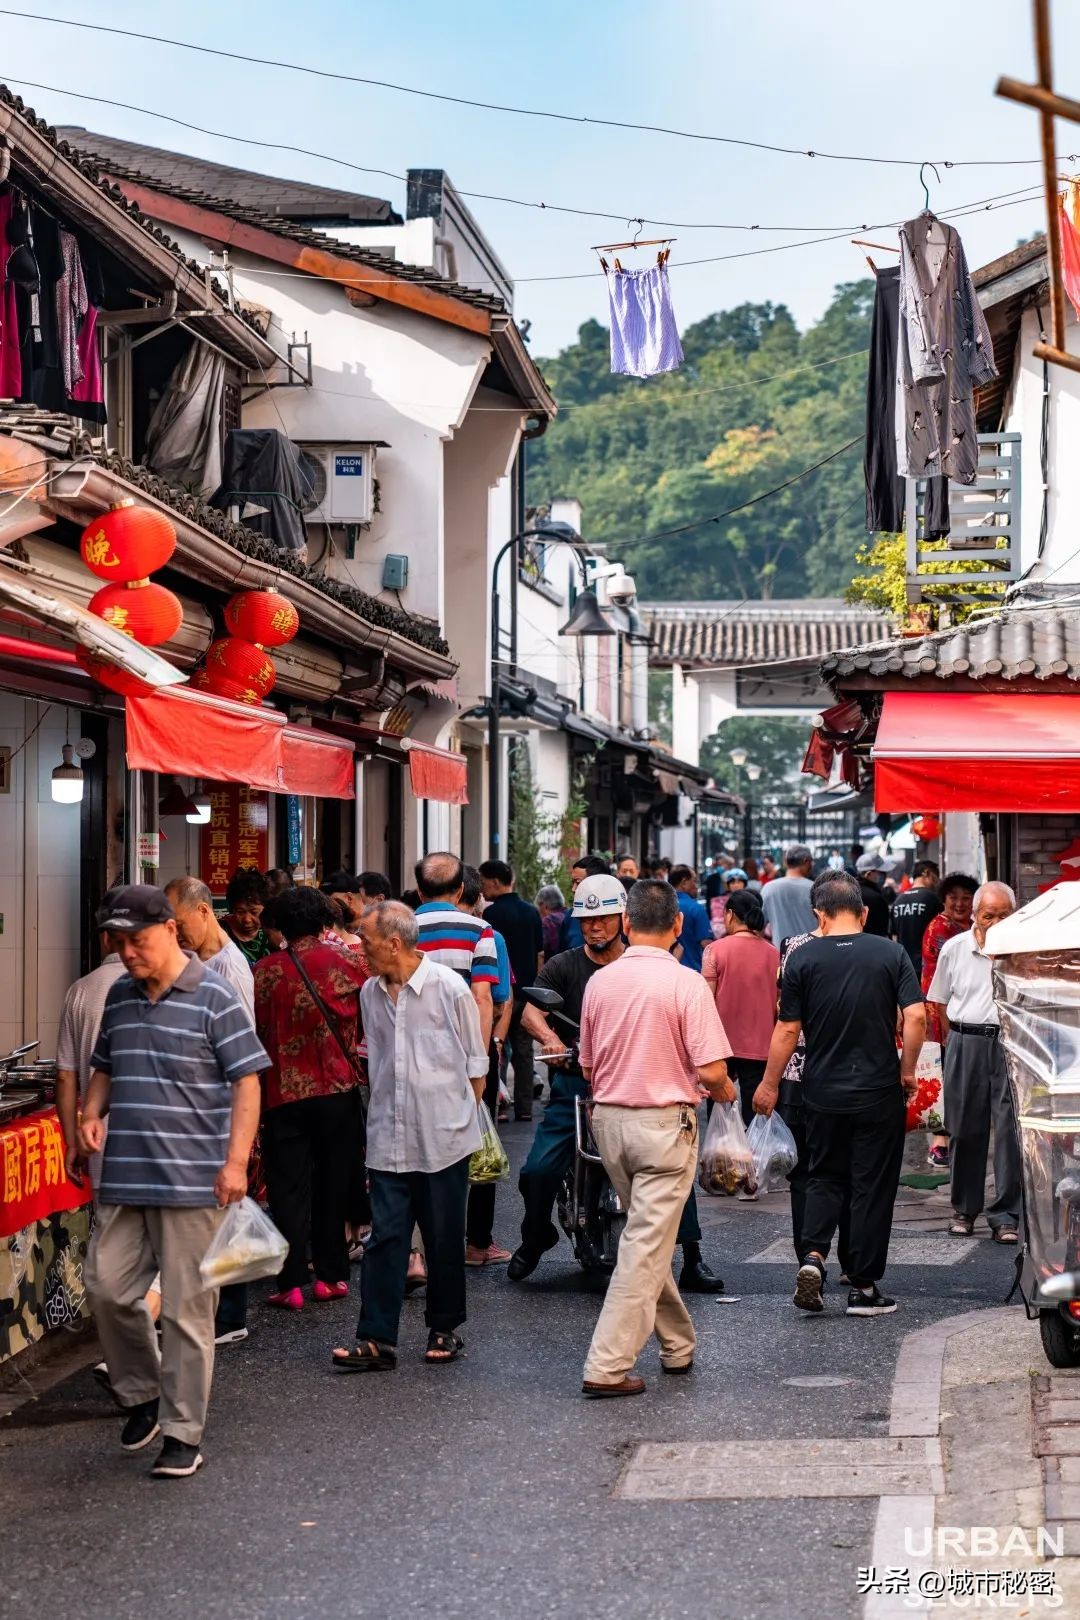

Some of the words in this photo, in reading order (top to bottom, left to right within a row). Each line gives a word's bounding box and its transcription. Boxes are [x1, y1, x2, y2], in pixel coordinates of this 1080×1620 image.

[336, 458, 361, 466] KELON
[208, 792, 230, 885] 驻杭直销点
[893, 902, 927, 918] STAFF
[2, 1116, 82, 1203] 厨房新
